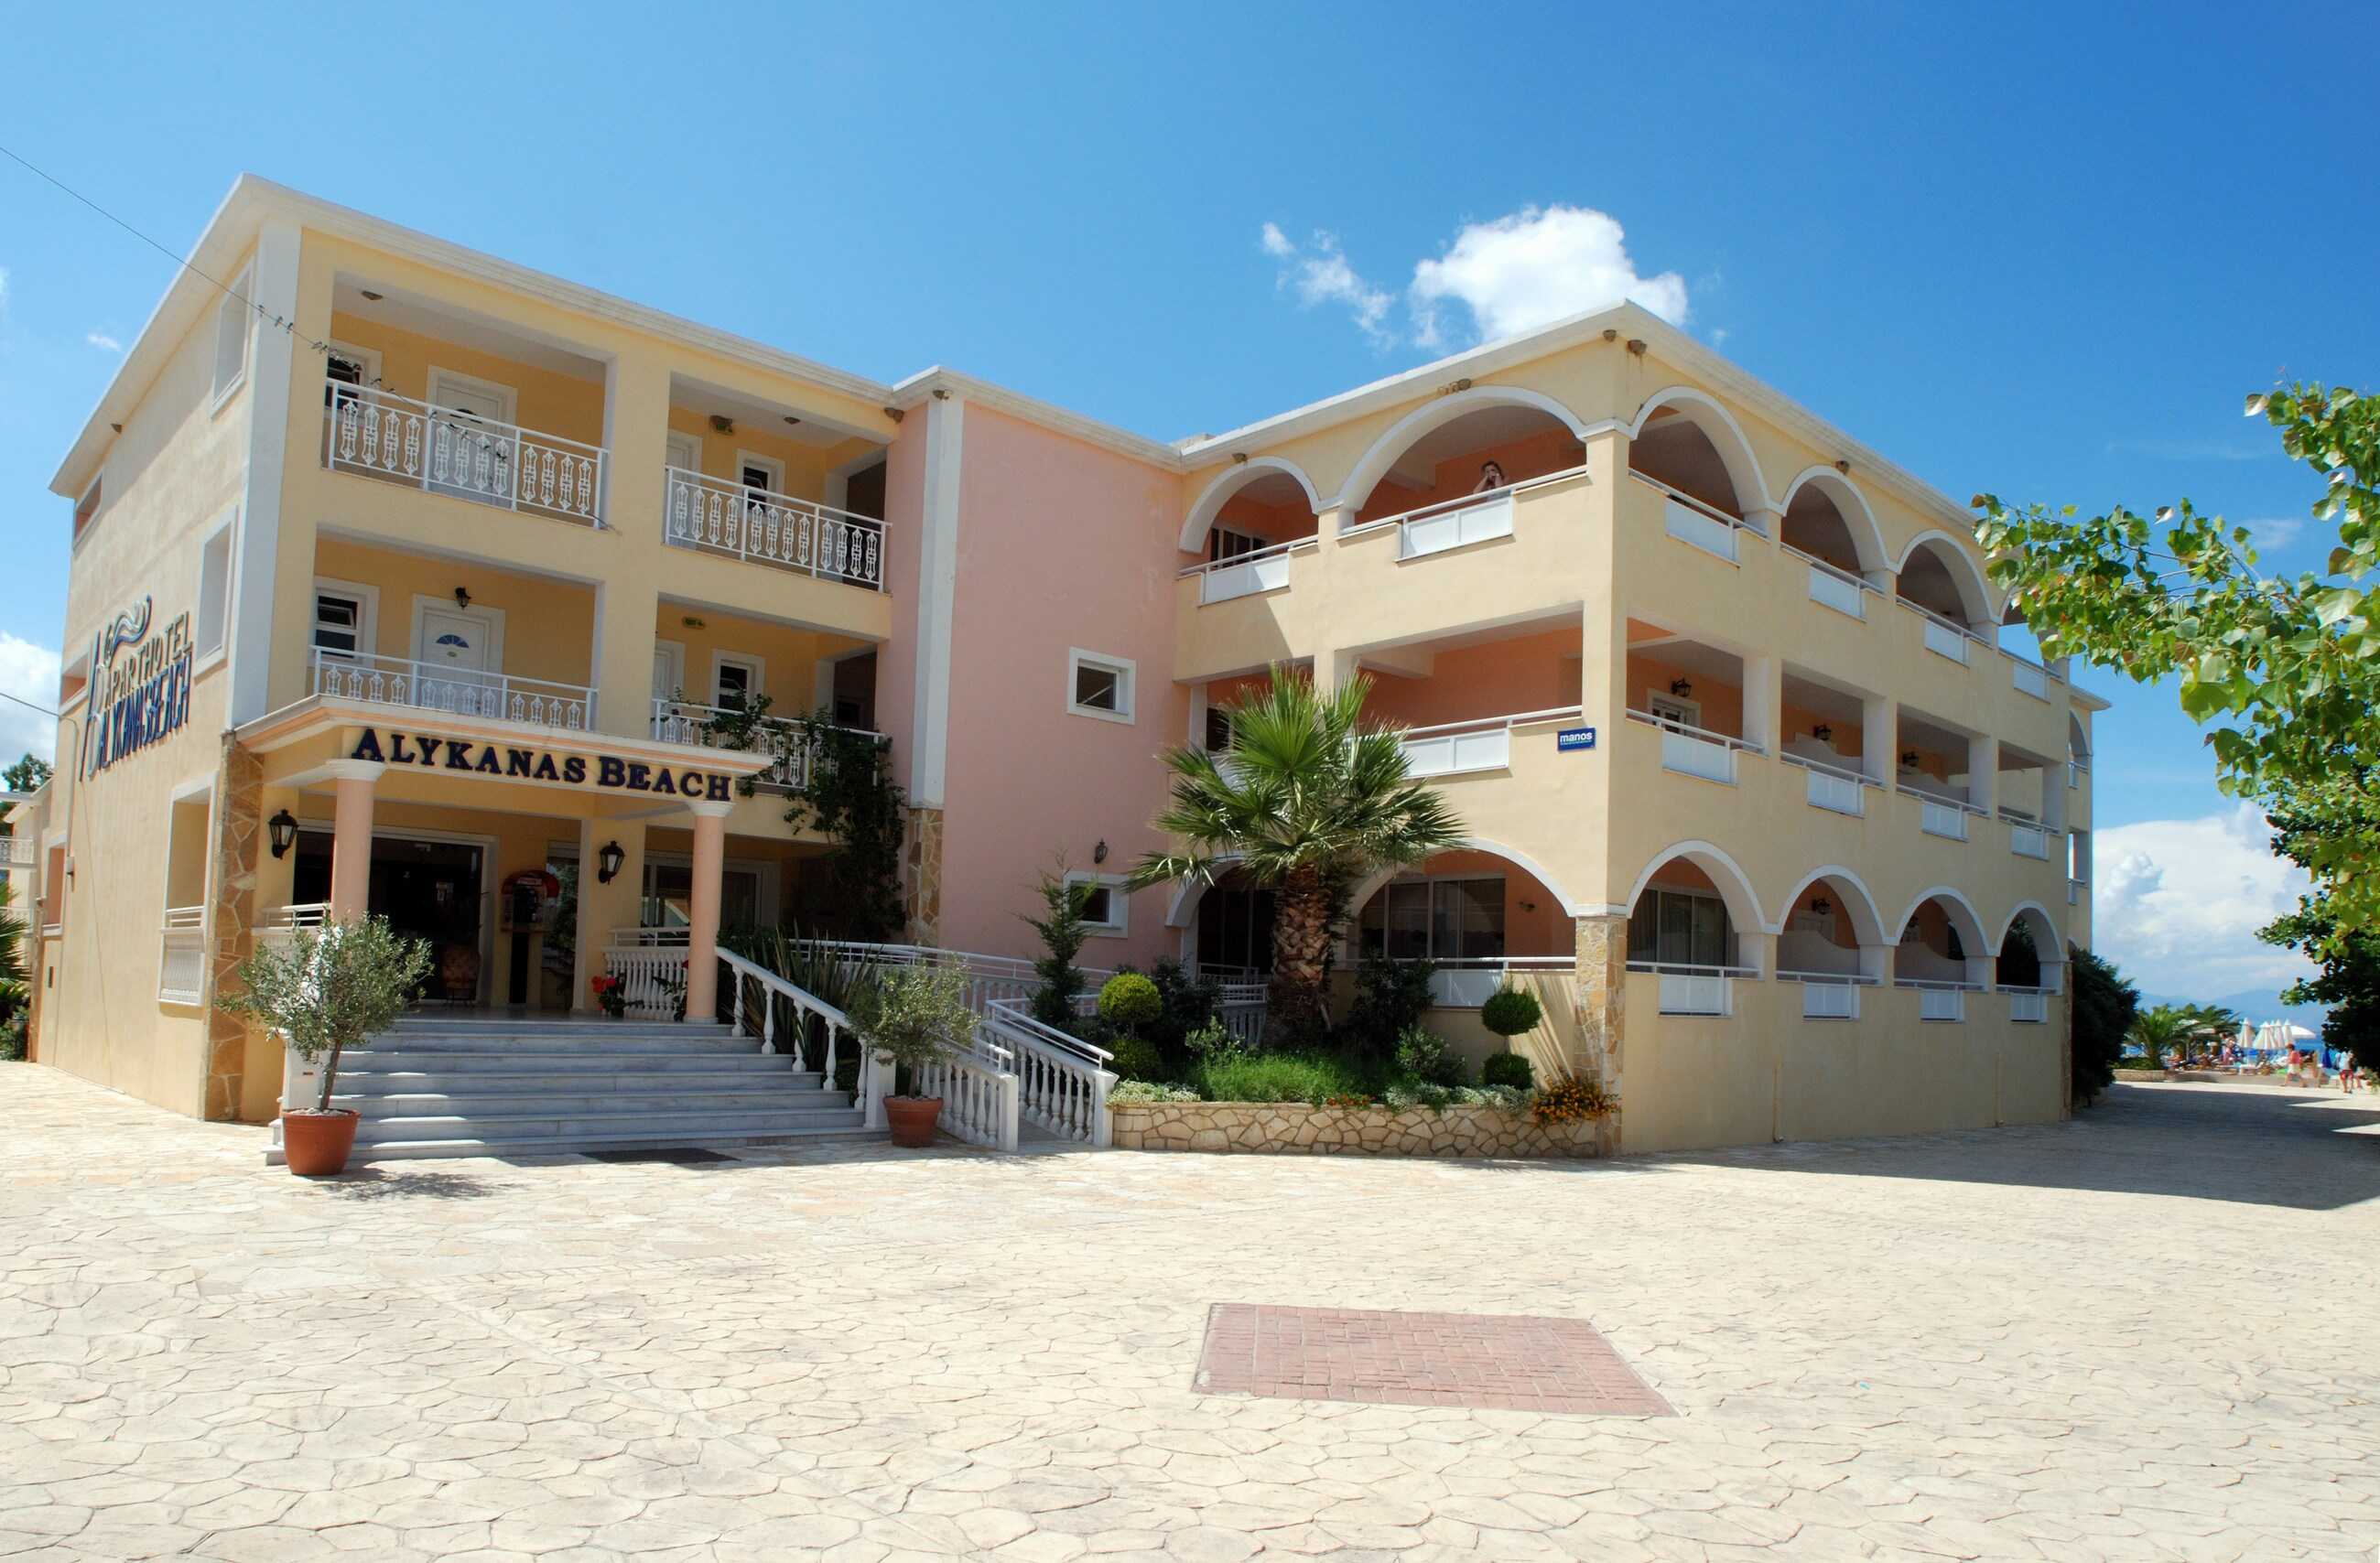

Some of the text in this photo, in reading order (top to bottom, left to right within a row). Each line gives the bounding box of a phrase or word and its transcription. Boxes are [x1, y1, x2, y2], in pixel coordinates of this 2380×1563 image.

[105, 611, 193, 711] APARTHOTEL
[352, 728, 731, 802] ALYKANAS BEACH
[1560, 732, 1593, 743] manos
